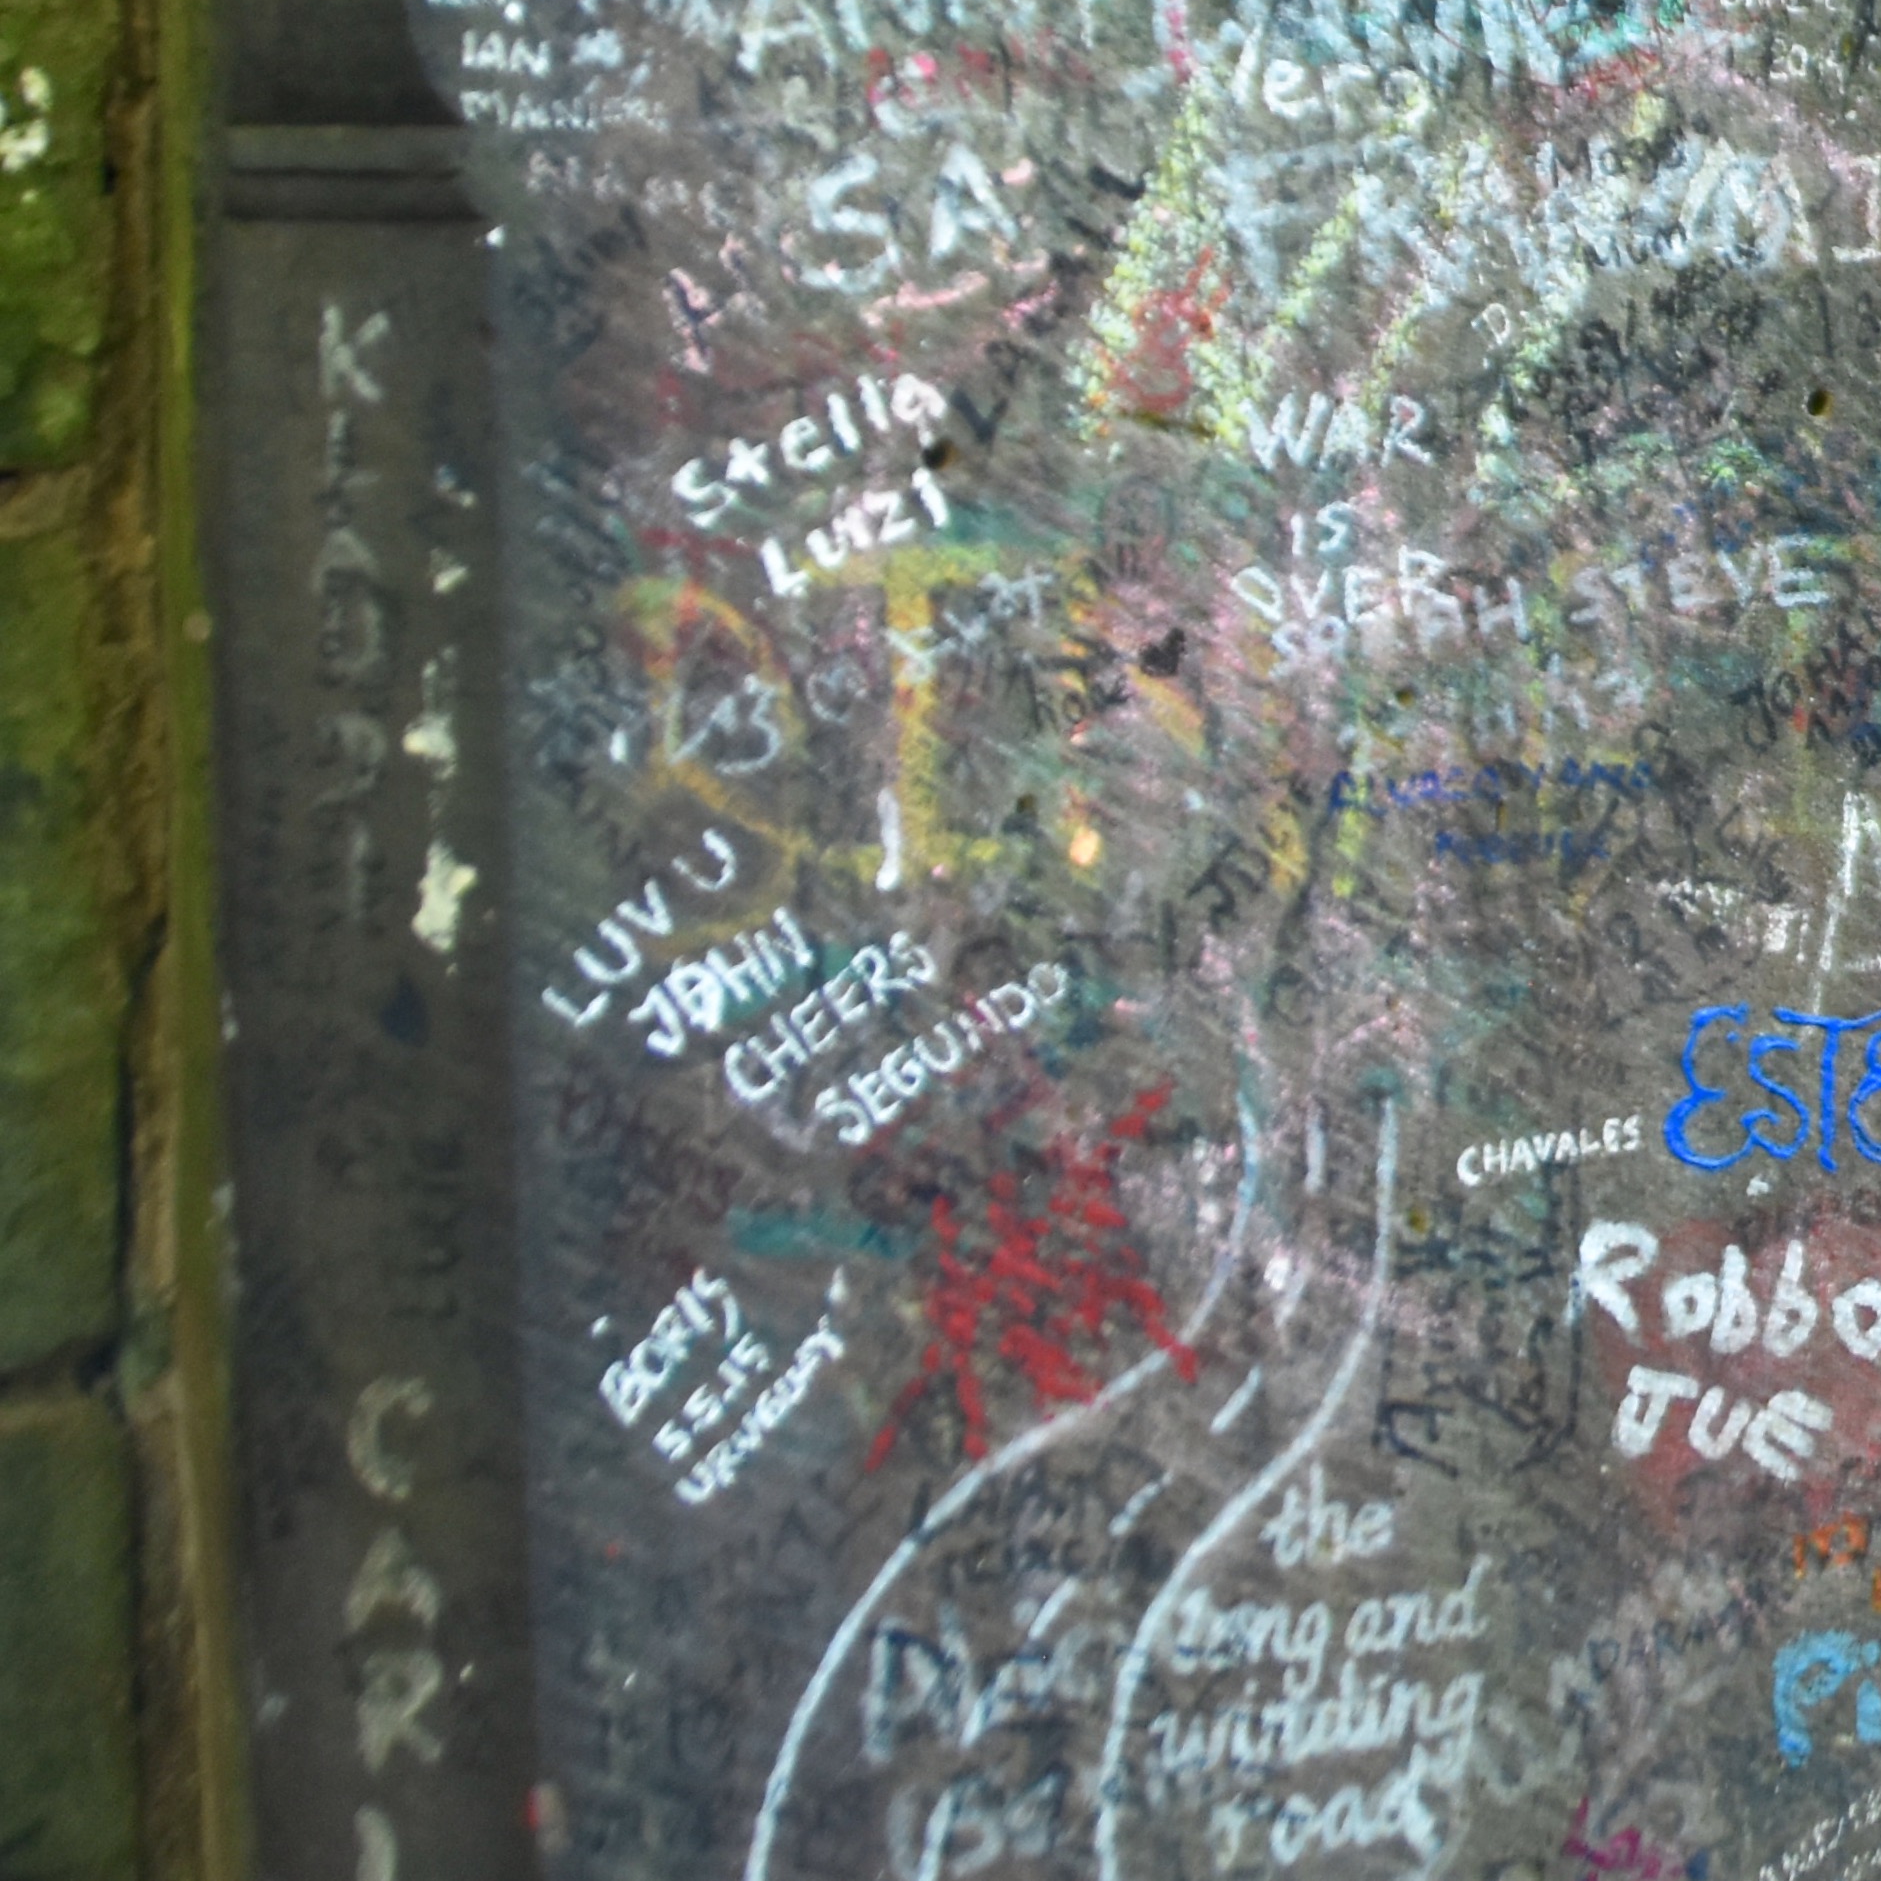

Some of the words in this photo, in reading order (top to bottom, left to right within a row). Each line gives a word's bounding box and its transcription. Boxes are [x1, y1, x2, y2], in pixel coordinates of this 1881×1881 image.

[670, 371, 949, 528] Stella
[1238, 389, 1436, 474] WAR
[1230, 543, 1448, 625] OVER
[1290, 499, 1354, 560] IS
[541, 879, 673, 1029] LUV
[670, 827, 738, 894] U
[723, 929, 938, 1106] CHEERS
[813, 959, 1070, 1148] SEGUNDO
[1455, 1113, 1643, 1189] CHAVALES
[1260, 1460, 1394, 1569] the
[1343, 1553, 1489, 1657] and
[1148, 1659, 1486, 1787] winding
